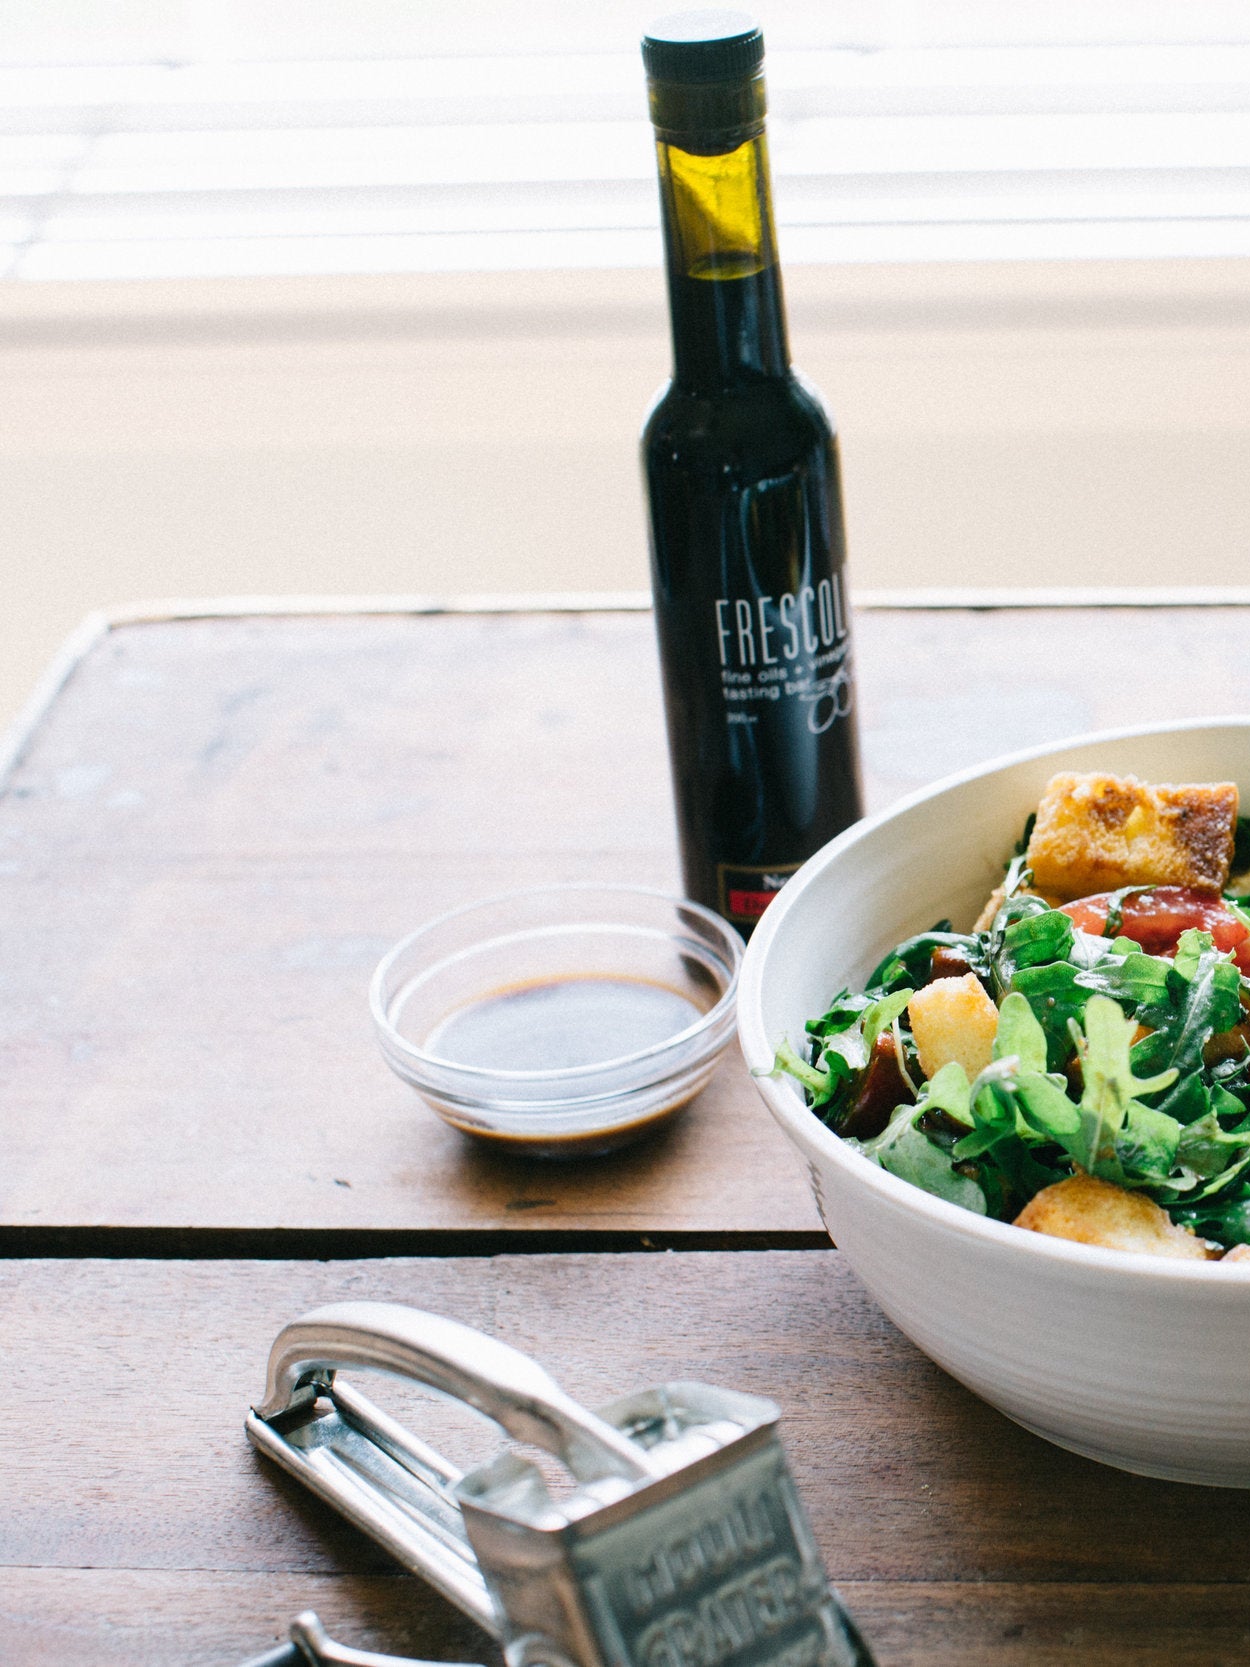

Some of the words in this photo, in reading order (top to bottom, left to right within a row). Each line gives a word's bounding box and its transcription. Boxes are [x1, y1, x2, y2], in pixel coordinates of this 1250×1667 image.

[721, 669, 751, 684] fine
[758, 667, 788, 683] oils
[723, 685, 780, 701] tasting
